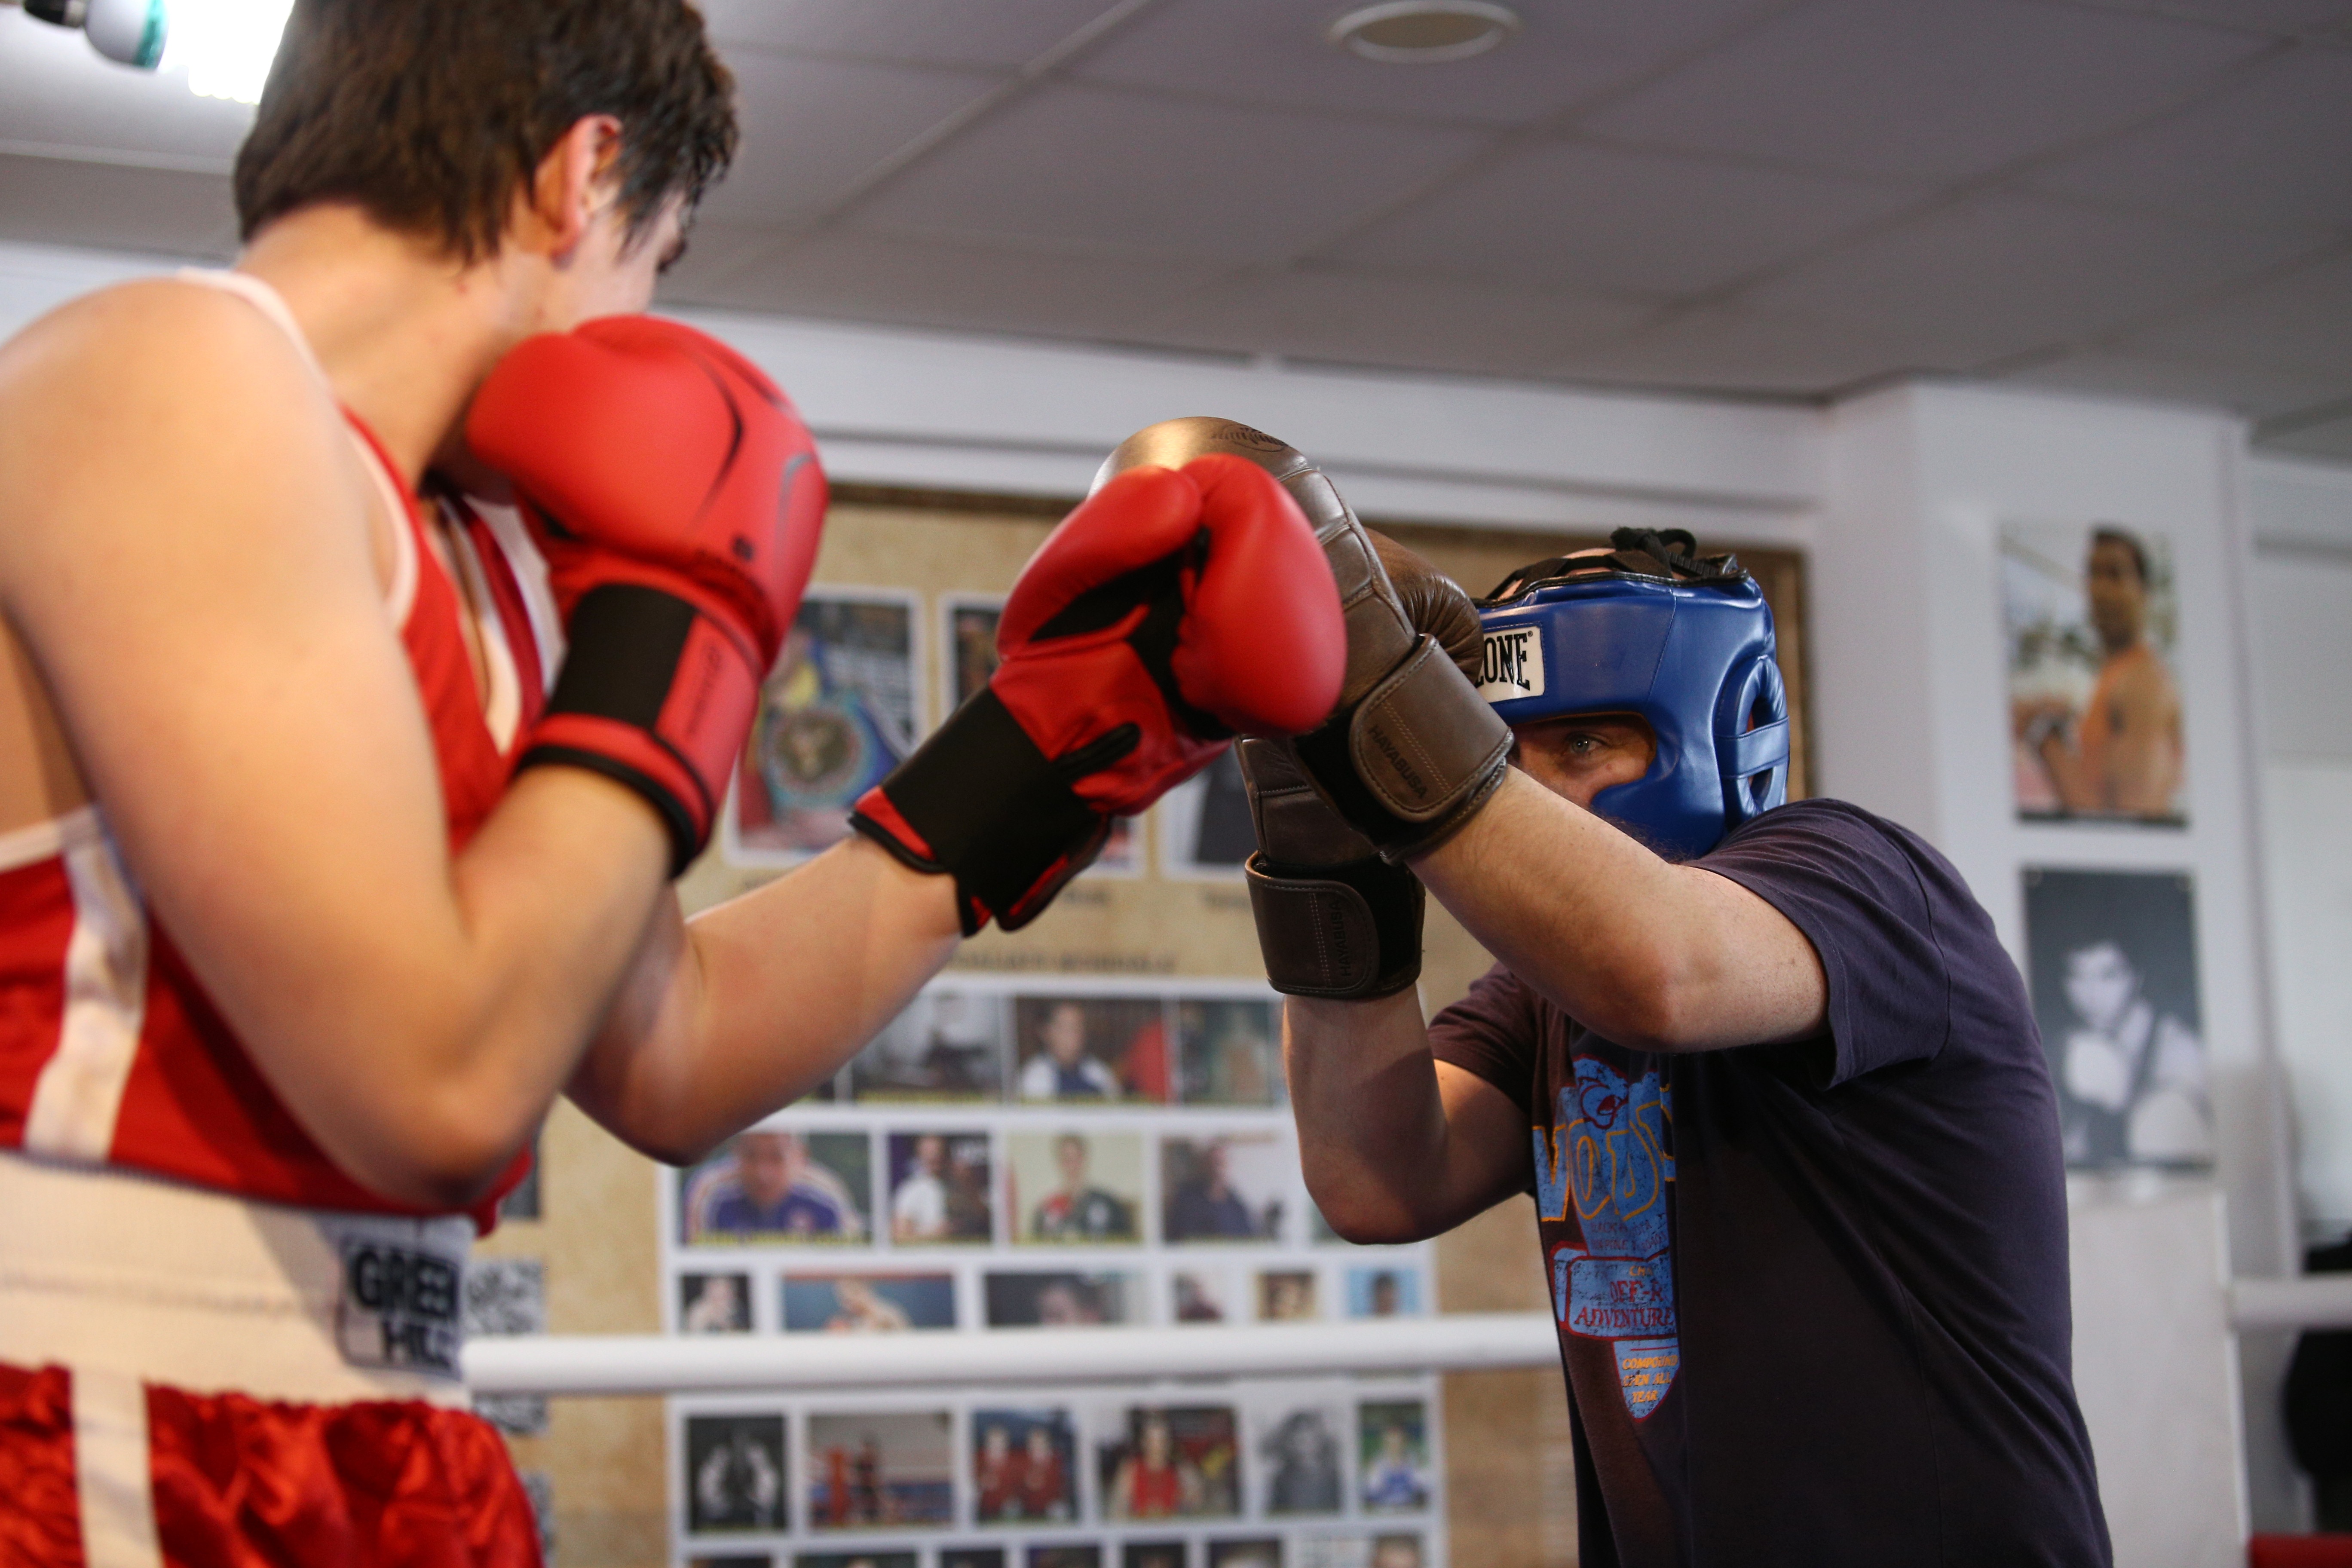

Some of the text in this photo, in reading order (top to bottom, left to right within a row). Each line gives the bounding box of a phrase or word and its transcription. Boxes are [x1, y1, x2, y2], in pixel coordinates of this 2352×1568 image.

[1368, 725, 1428, 799] HAYABUSA
[1328, 897, 1352, 977] HAYABUSA
[1622, 1355, 1678, 1370] COMPOUND
[1653, 1371, 1672, 1385] ALL
[1632, 1390, 1658, 1403] YEAR
